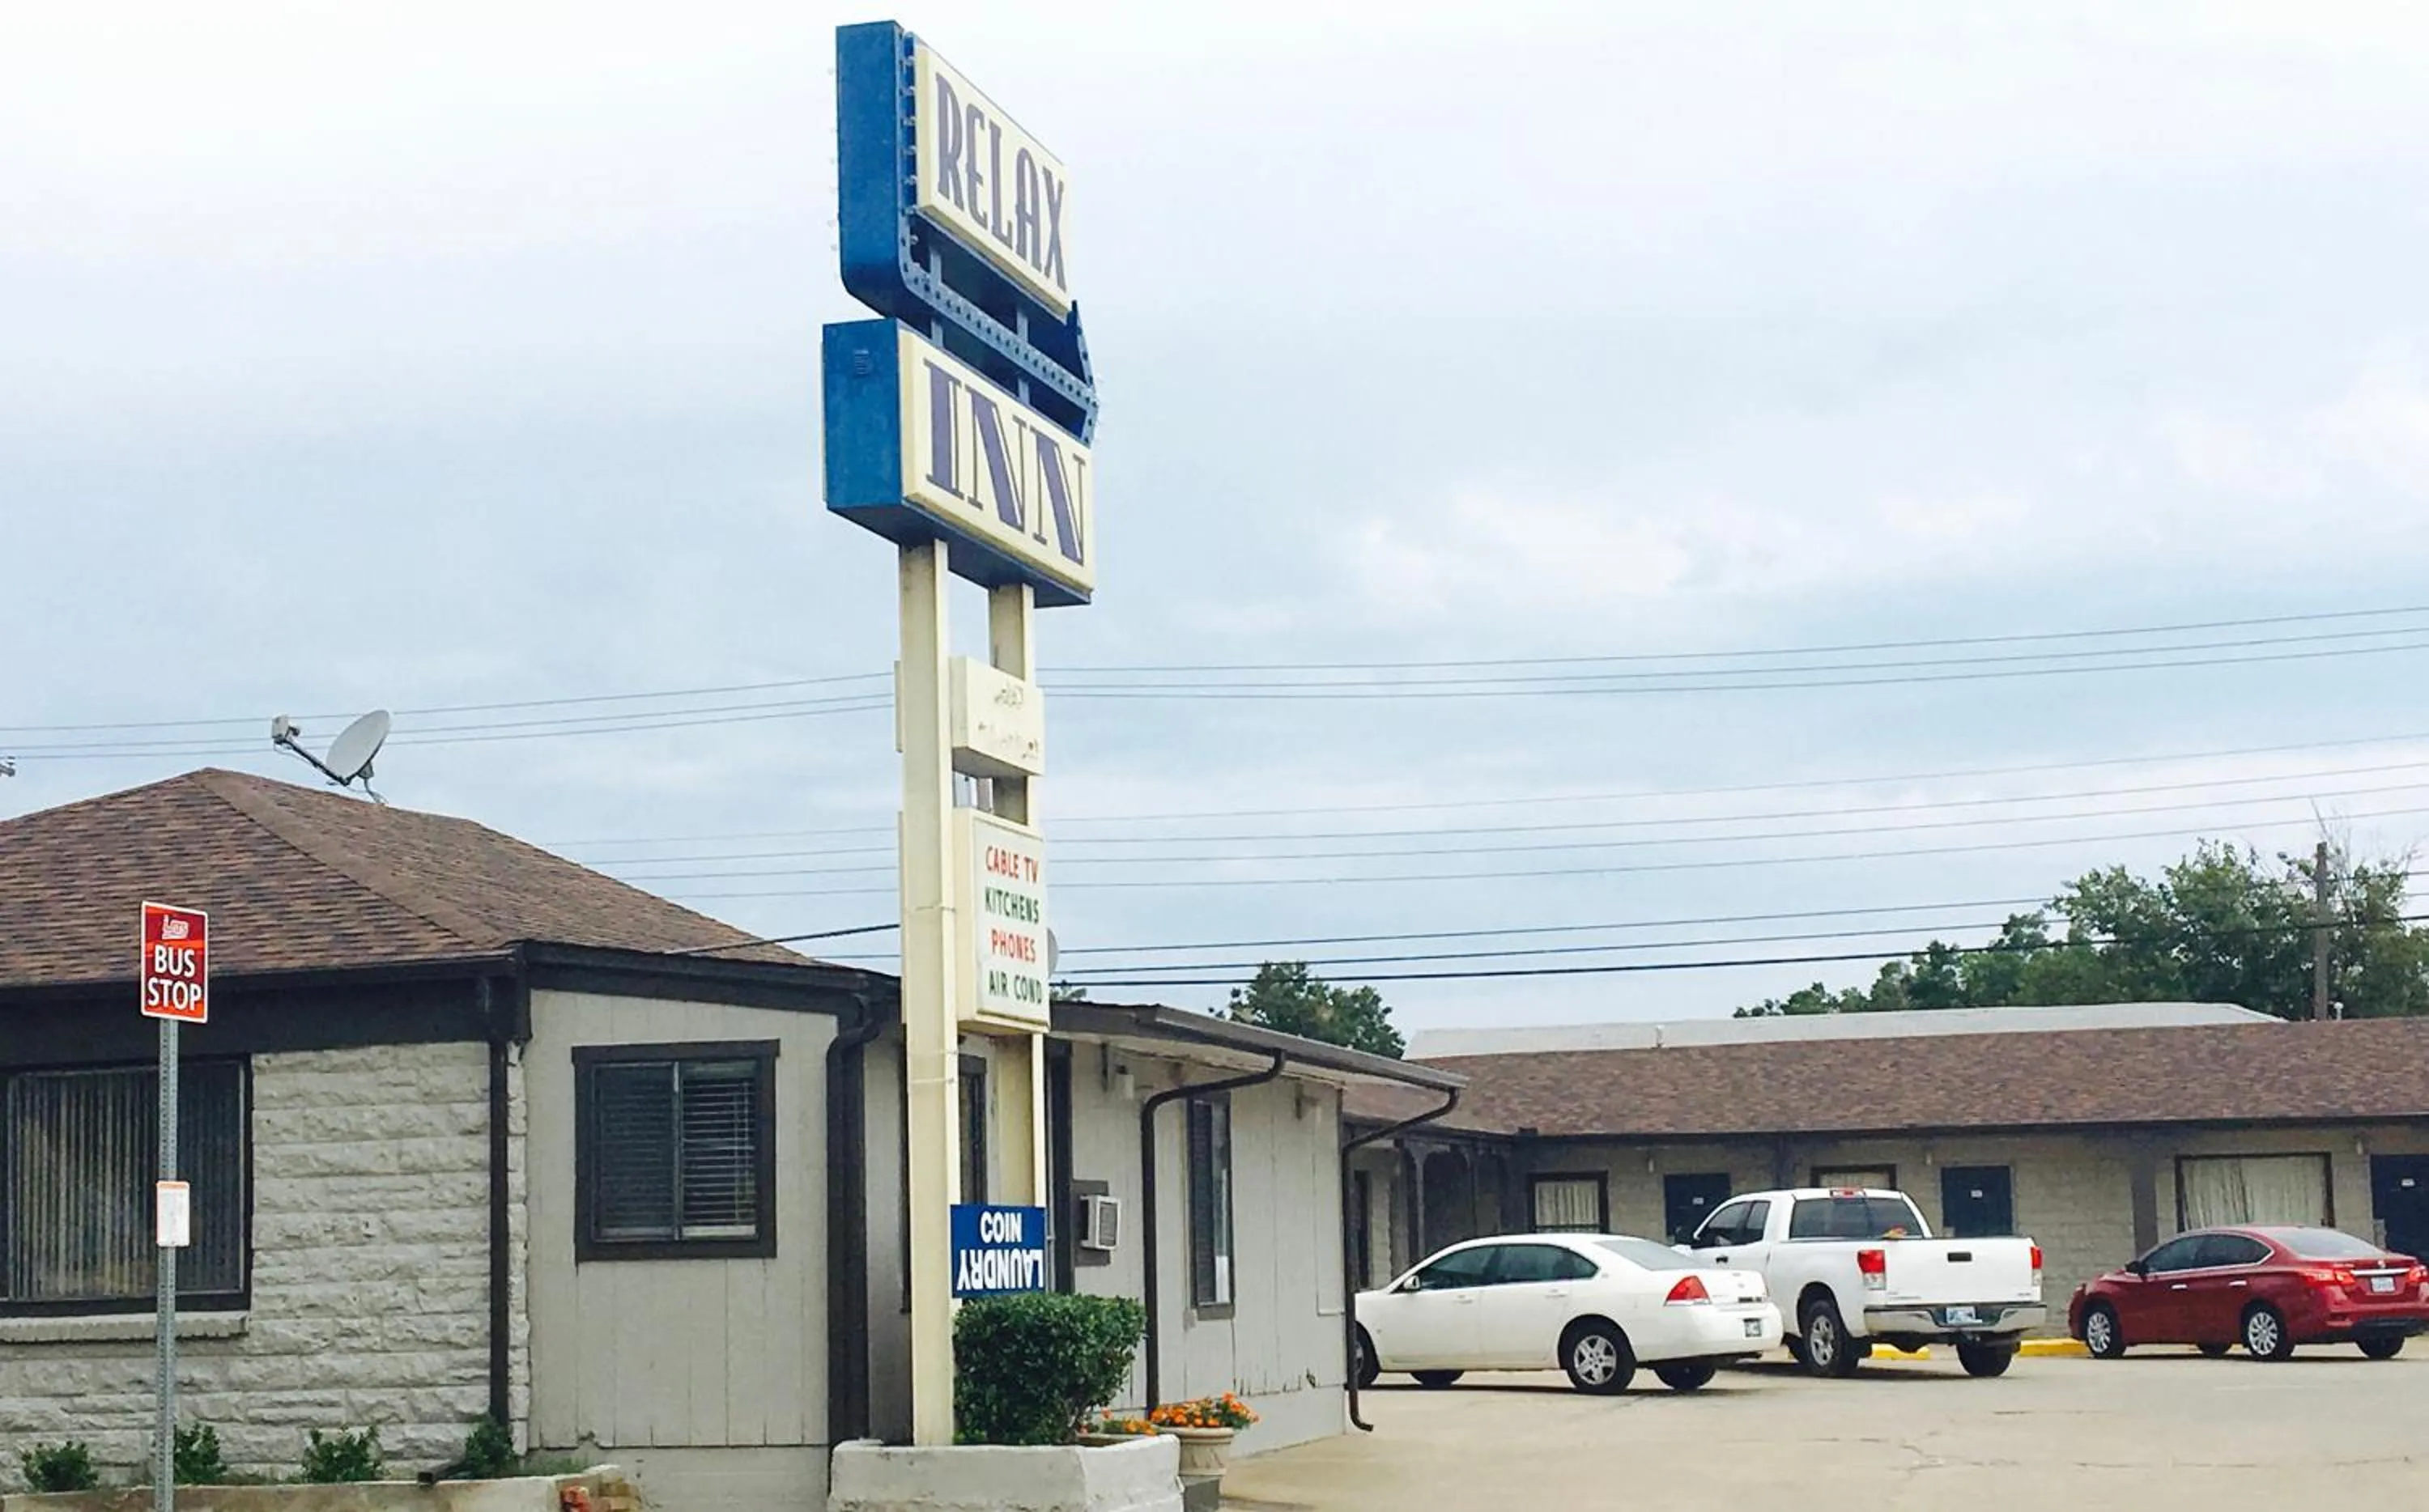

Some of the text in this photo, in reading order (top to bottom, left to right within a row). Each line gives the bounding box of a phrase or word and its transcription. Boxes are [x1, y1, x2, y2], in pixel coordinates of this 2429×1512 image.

[936, 71, 1066, 292] RELAX
[923, 358, 1086, 567] INN
[985, 845, 1038, 883] CABLE TV
[985, 887, 1040, 924] KITCHENS
[155, 945, 195, 978] BUS
[992, 928, 1036, 962] PHONES
[147, 977, 202, 1010] STOP
[989, 970, 1042, 1004] AIR COND
[980, 1211, 1023, 1243] COIN
[956, 1248, 1044, 1290] LAUNDRY
